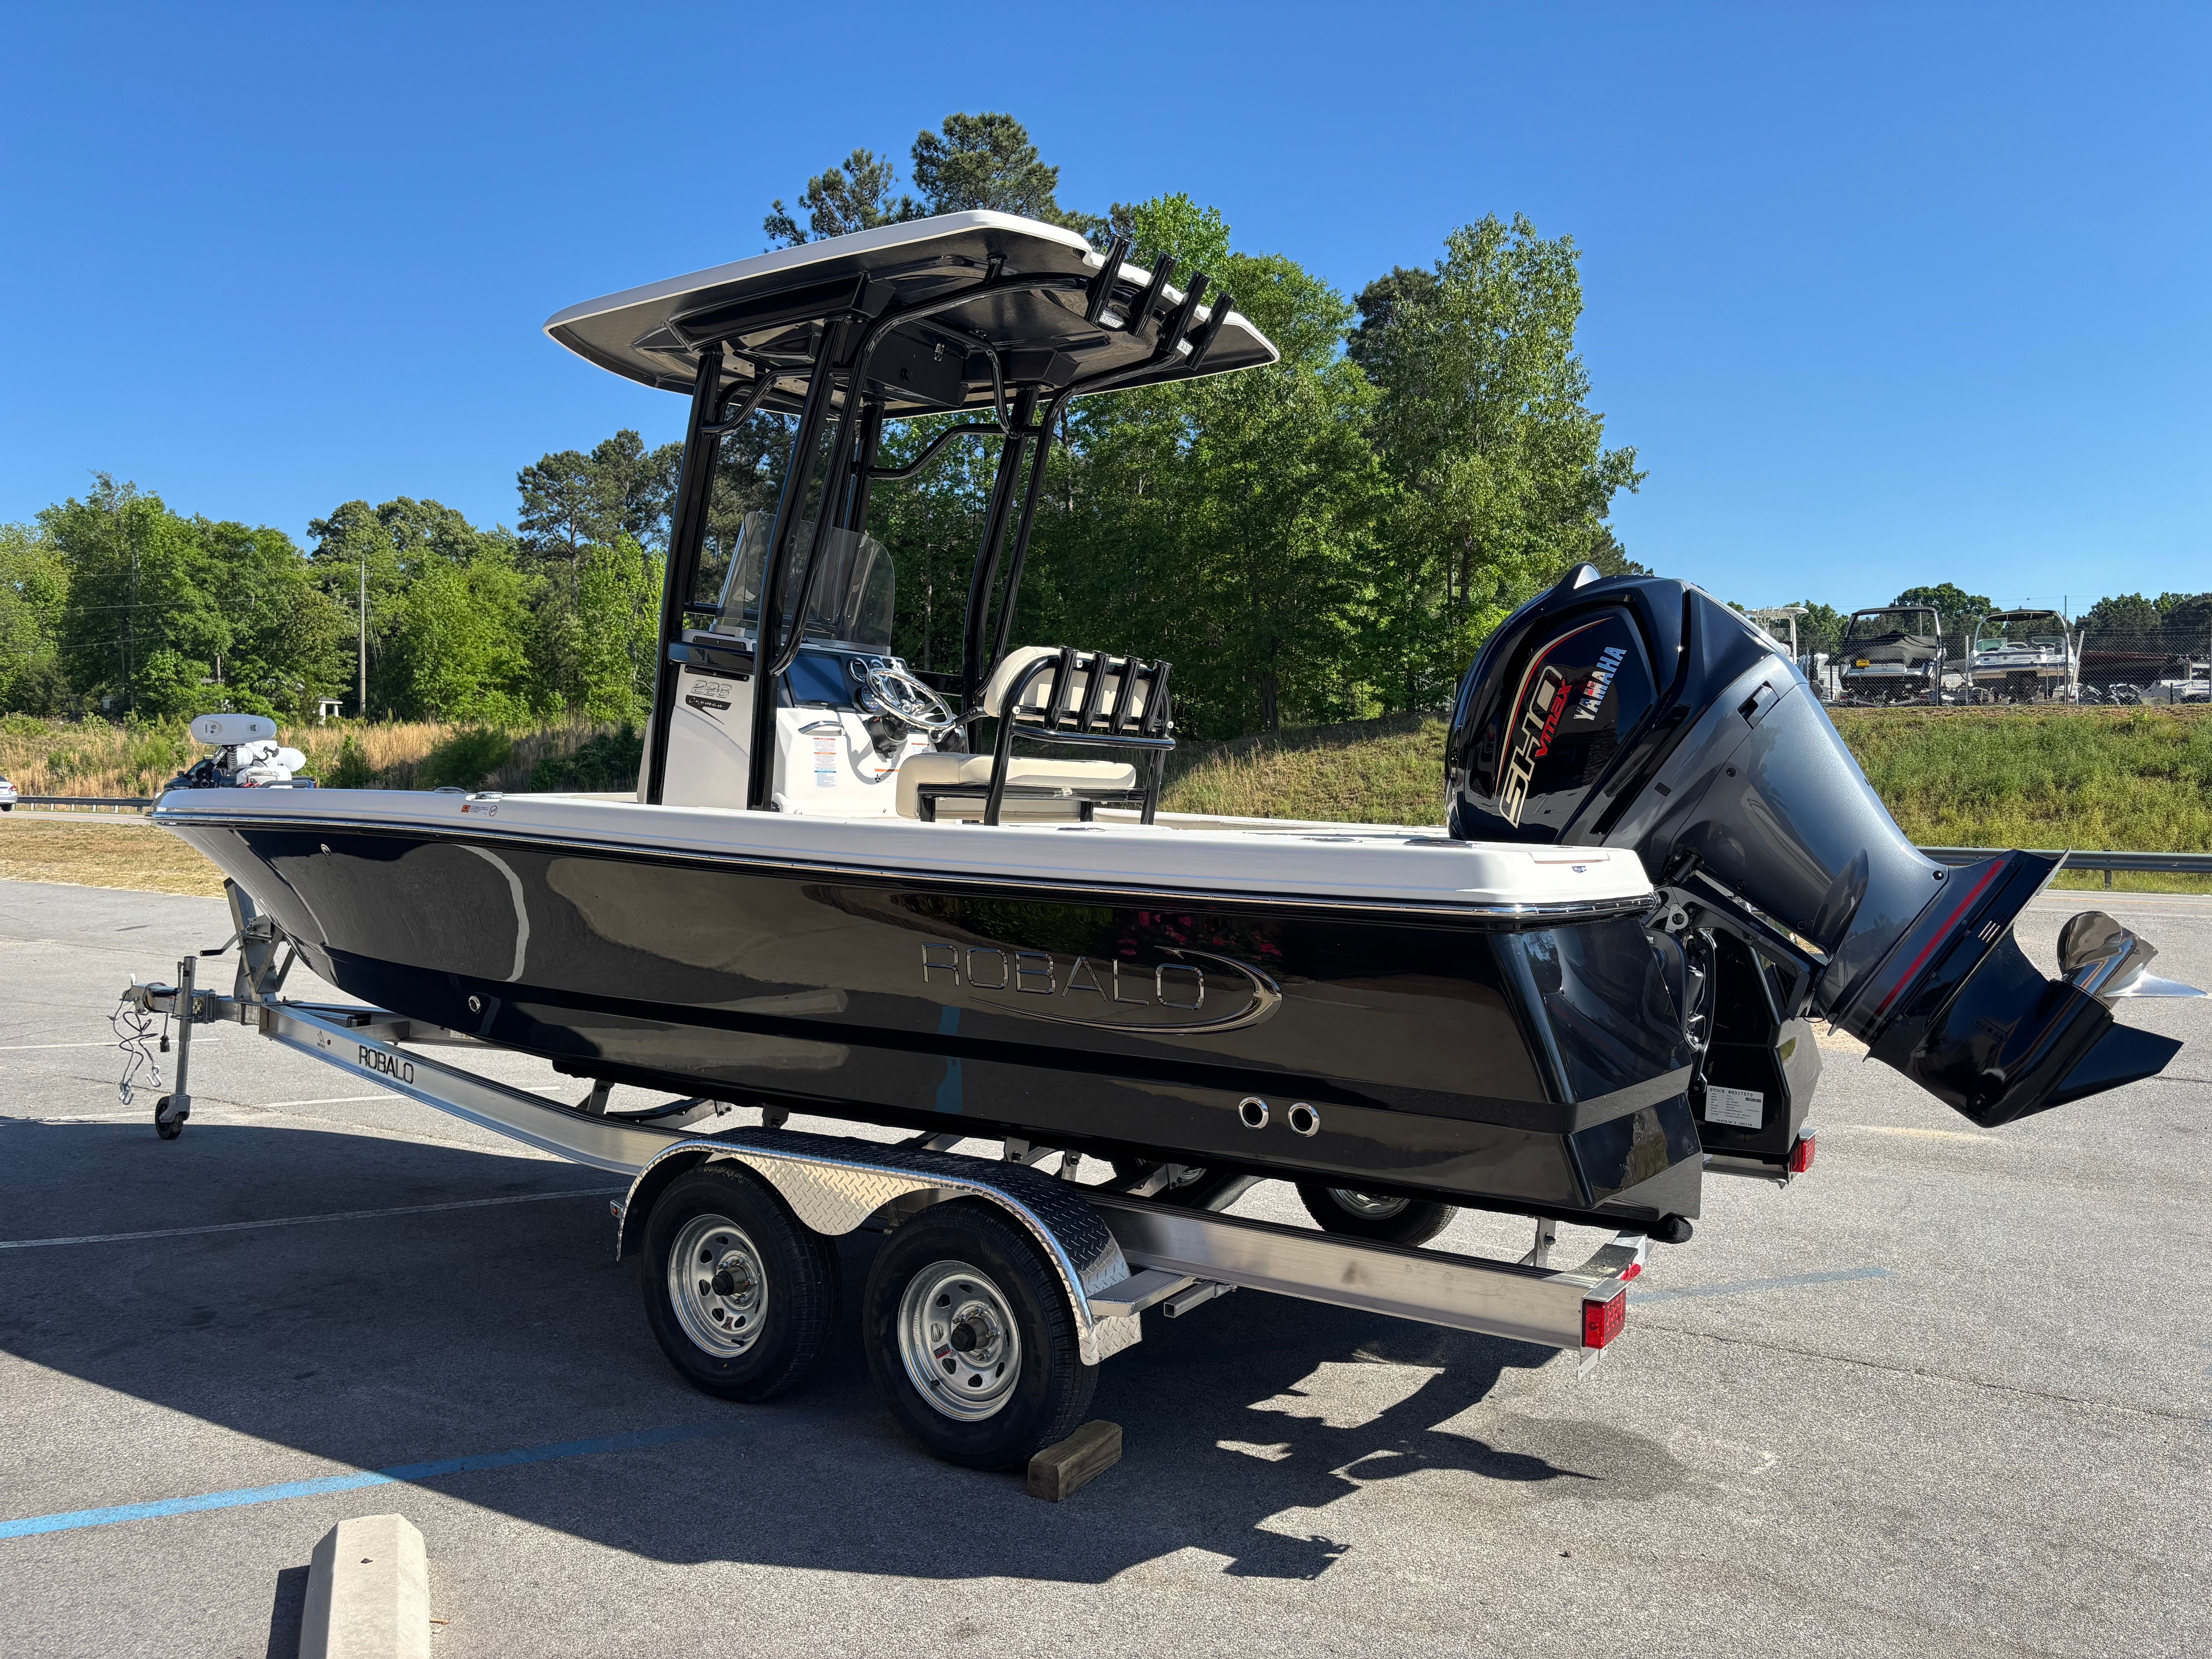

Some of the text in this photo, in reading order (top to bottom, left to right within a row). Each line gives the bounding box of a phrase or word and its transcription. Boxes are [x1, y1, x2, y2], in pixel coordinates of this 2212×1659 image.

[689, 697, 725, 708] Cayman
[690, 680, 732, 698] 226
[1573, 646, 1627, 721] YAMAHA
[1499, 665, 1563, 829] SHO
[921, 941, 1205, 1010] ROBALO
[359, 1045, 414, 1084] ROBALO
